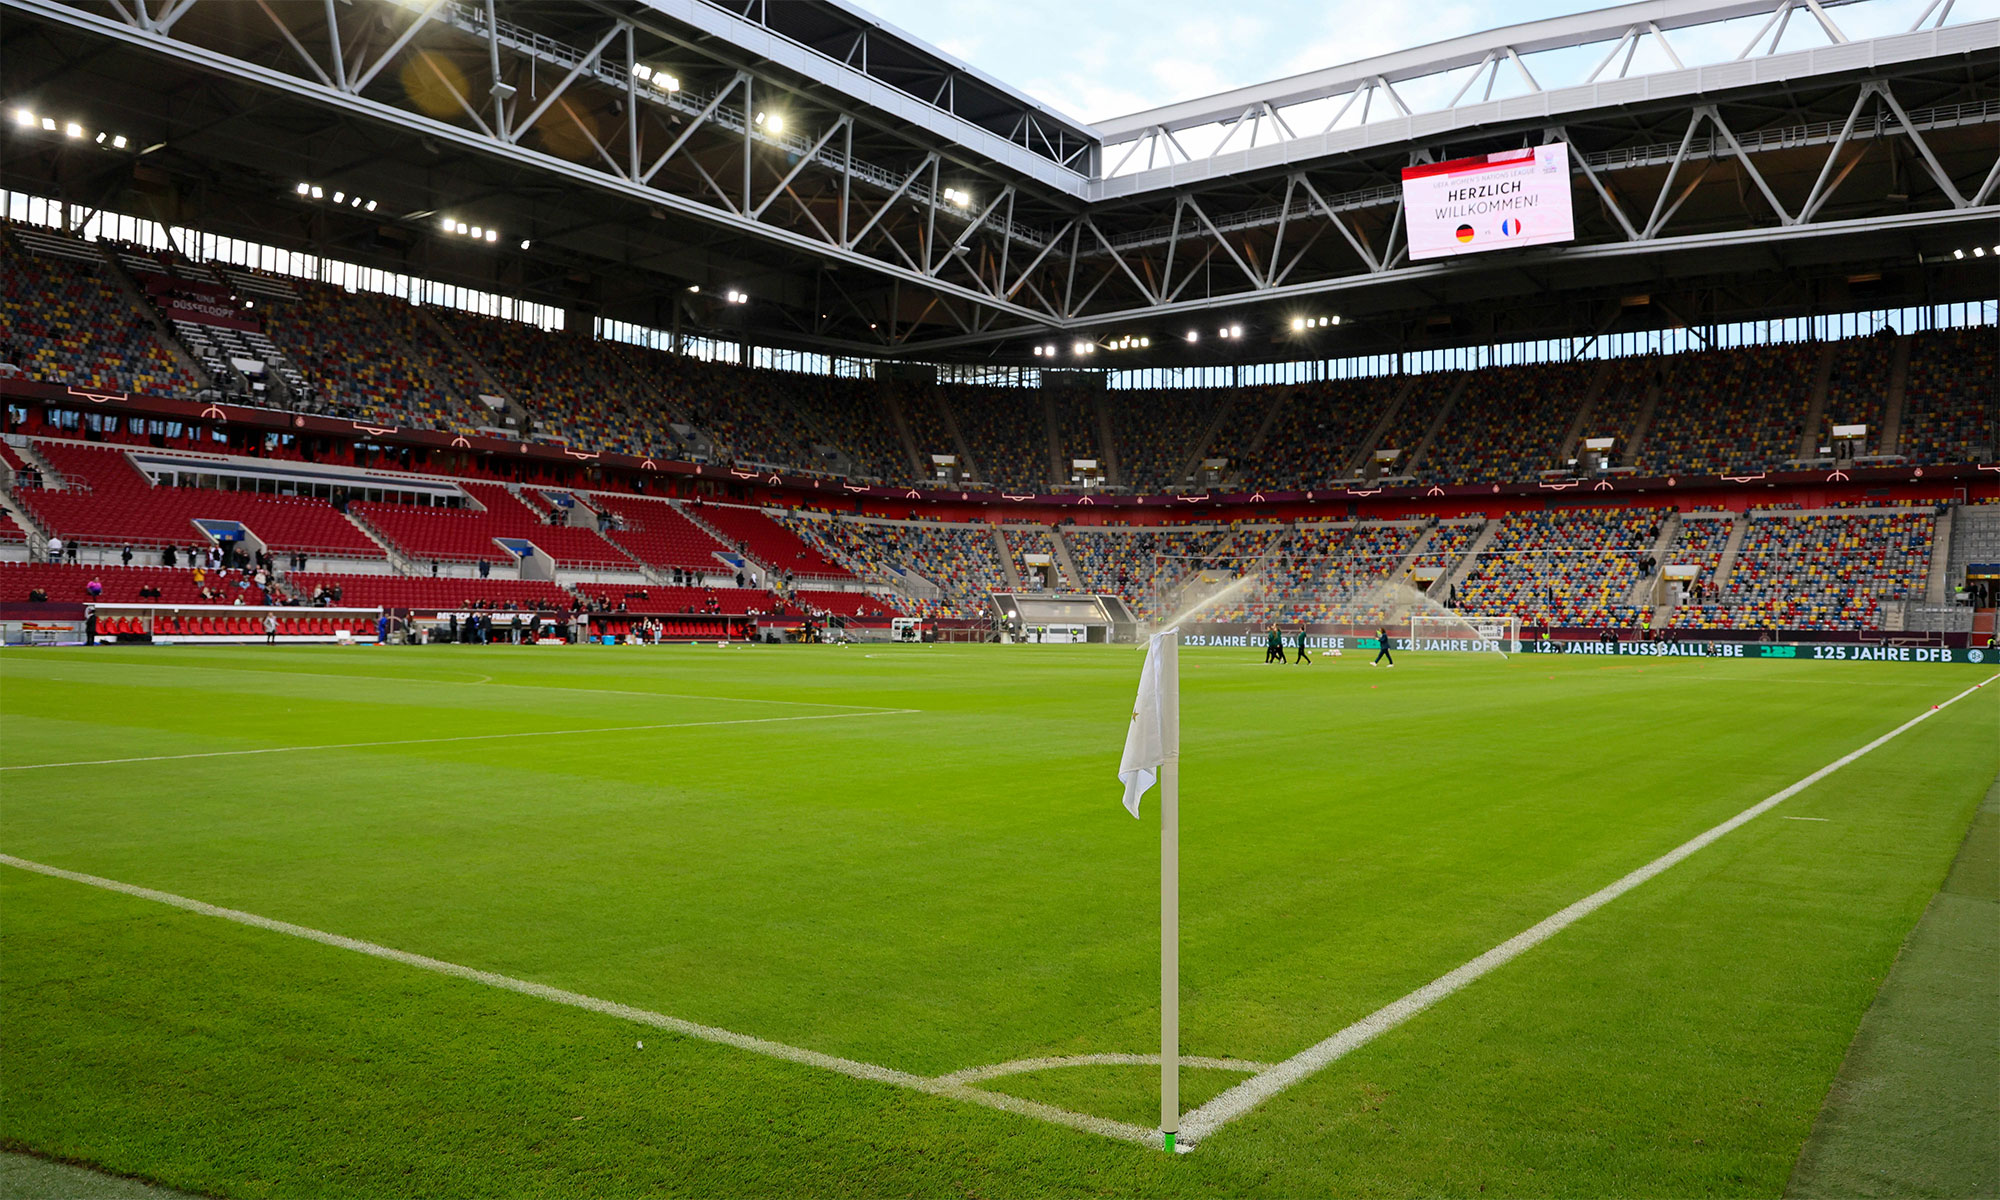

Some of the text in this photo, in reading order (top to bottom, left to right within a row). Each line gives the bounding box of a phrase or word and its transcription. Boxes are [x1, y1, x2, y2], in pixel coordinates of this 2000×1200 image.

[1481, 173, 1509, 182] NATIONS
[1510, 167, 1535, 177] LEAGUE
[1448, 181, 1521, 202] HERZLICH
[1435, 194, 1539, 220] WILLKOMMEN!
[1184, 635, 1206, 646] 125
[1208, 636, 1247, 647] JAHRE
[1424, 639, 1468, 651] JAHRE
[1472, 640, 1500, 652] DFB
[1565, 641, 1614, 654] JAHRE
[1619, 643, 1744, 657] FUSSBALLLEBE
[1813, 646, 1952, 662] 125 JAHRE DFB
